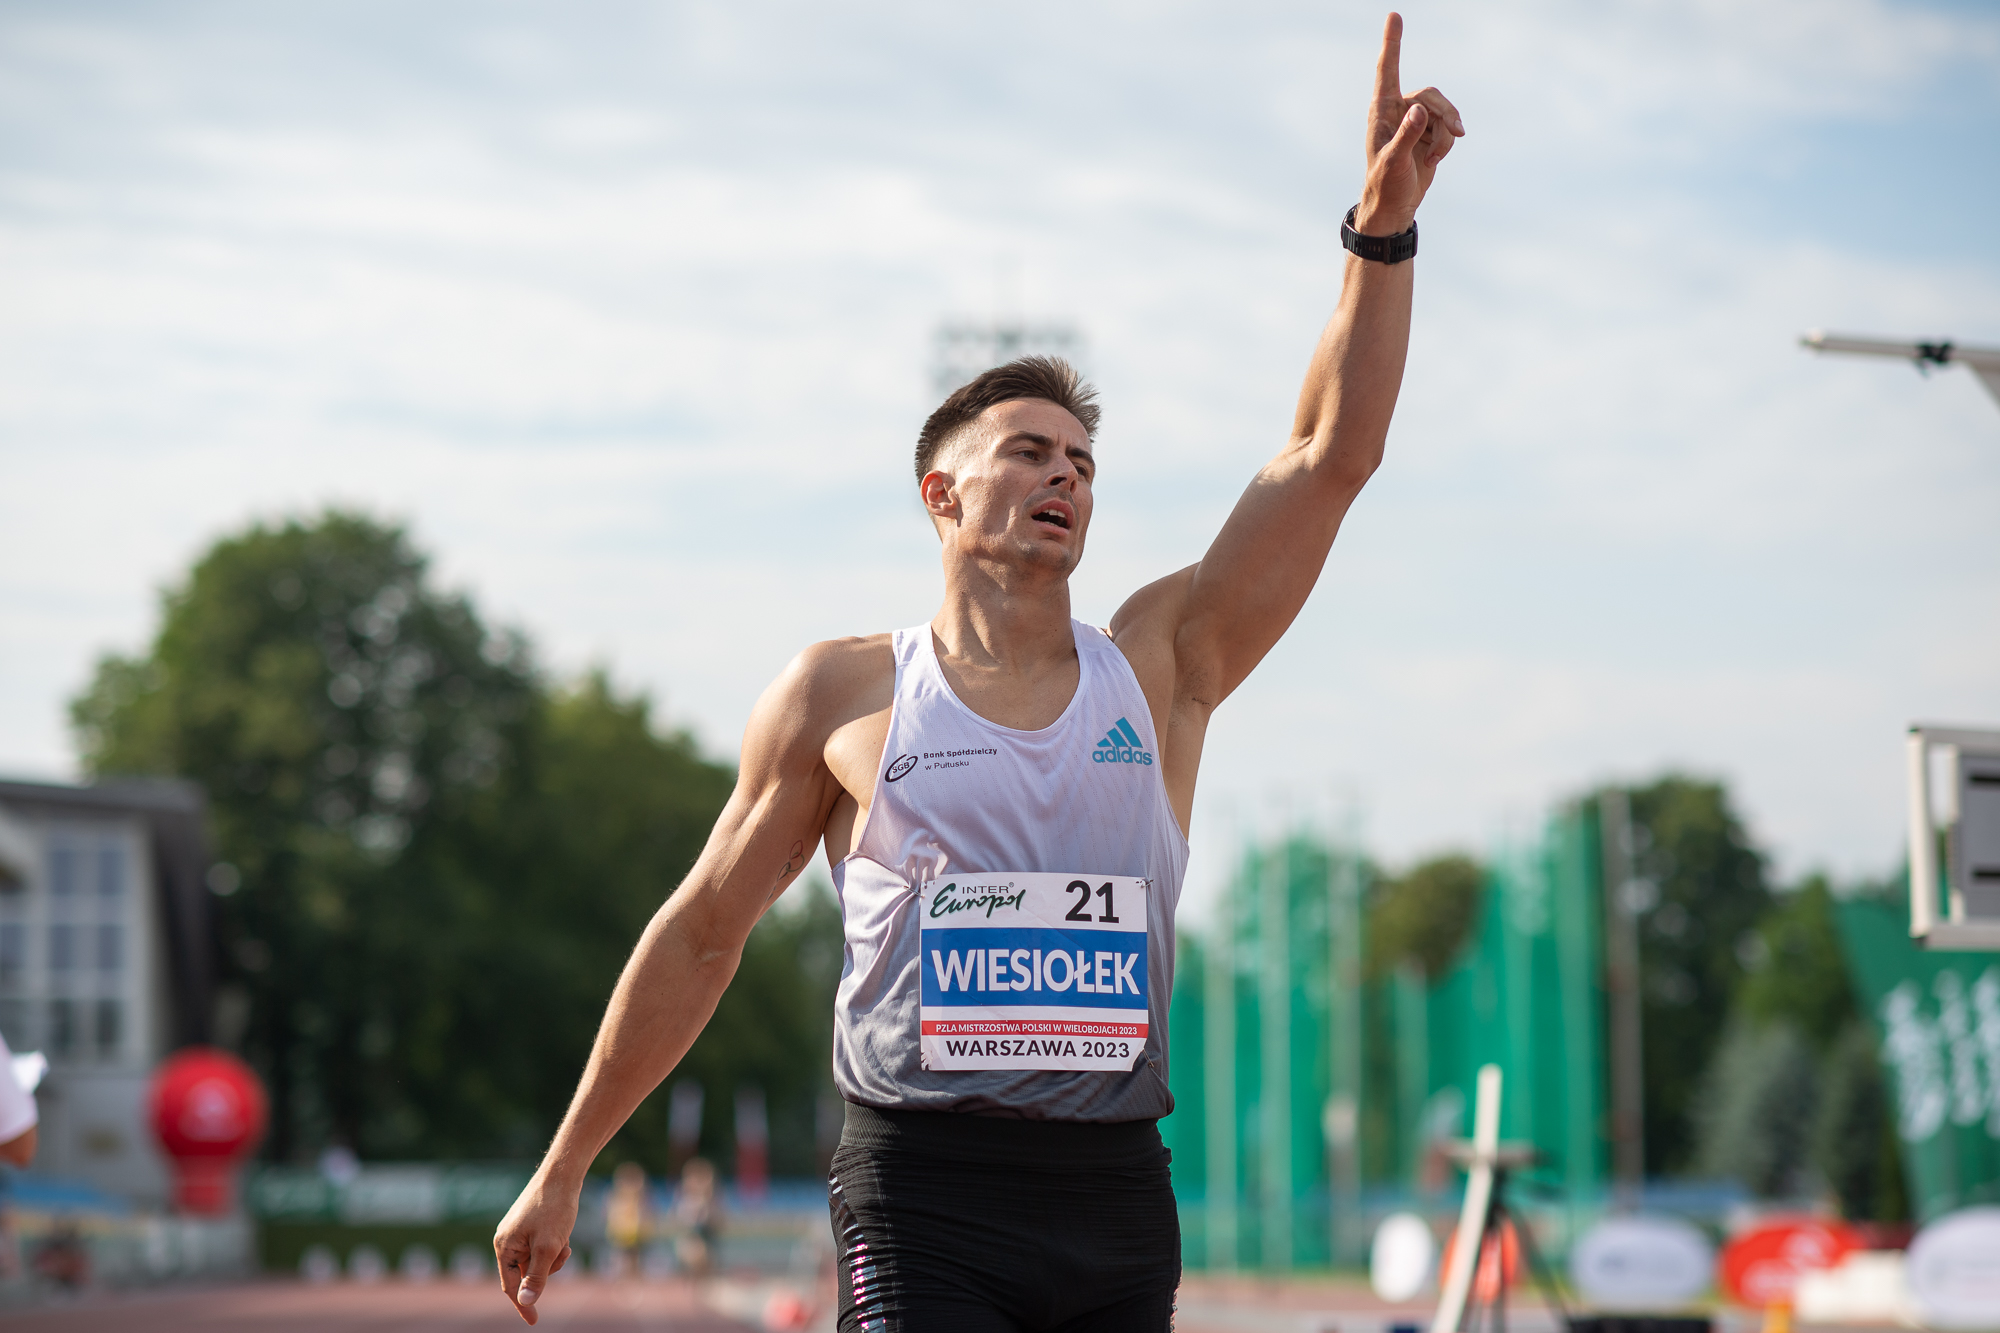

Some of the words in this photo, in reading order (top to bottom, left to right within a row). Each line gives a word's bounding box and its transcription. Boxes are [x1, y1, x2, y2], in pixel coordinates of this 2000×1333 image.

[947, 747, 998, 758] Spółdzielczy
[1092, 746, 1153, 766] adidas
[892, 761, 910, 774] SGB
[934, 760, 970, 770] Pułtusku
[930, 883, 1026, 918] Europol
[1064, 880, 1120, 924] 21
[931, 948, 1141, 995] WIESIOŁEK
[936, 1024, 957, 1033] PZLA
[960, 1024, 1020, 1033] MISTRZOSTWA
[1022, 1024, 1052, 1033] POLSKI
[1052, 1024, 1062, 1033] W
[1062, 1024, 1118, 1035] WIELOBOJACH
[1119, 1026, 1138, 1036] 2023
[946, 1040, 1077, 1058] WARSZAWA
[1082, 1041, 1130, 1058] 2023
